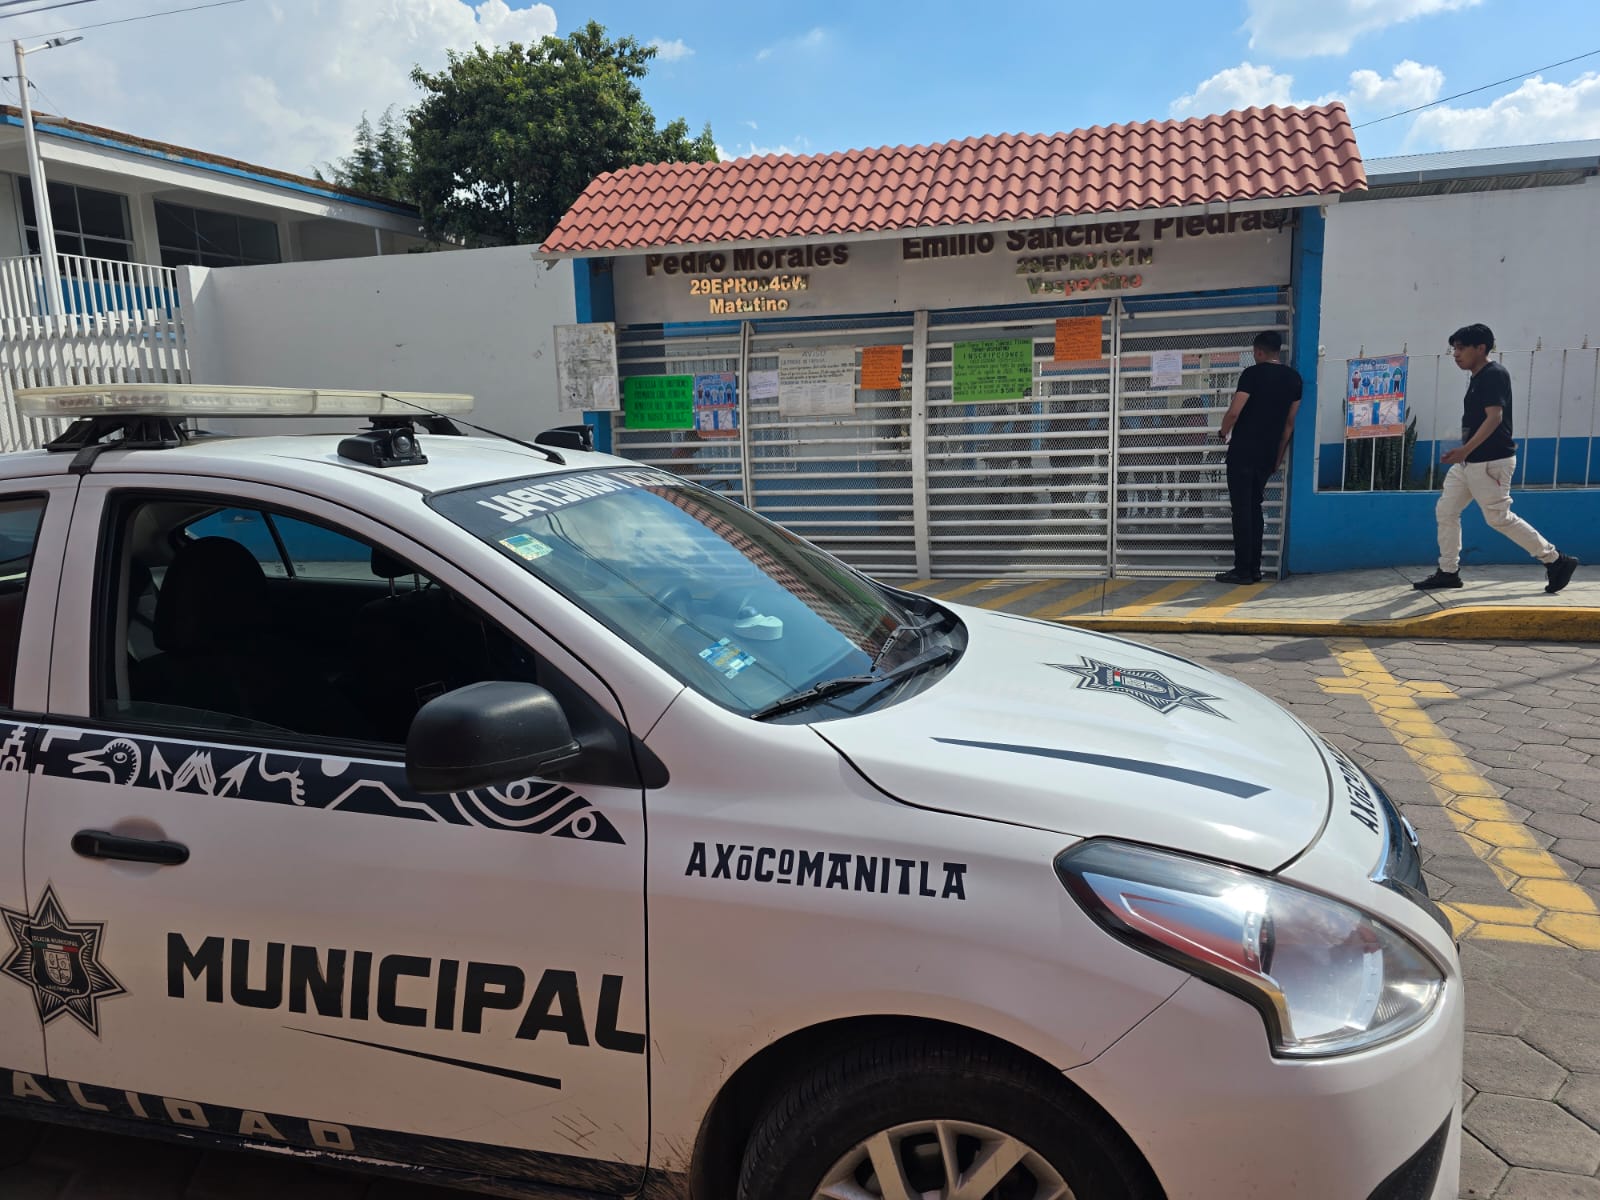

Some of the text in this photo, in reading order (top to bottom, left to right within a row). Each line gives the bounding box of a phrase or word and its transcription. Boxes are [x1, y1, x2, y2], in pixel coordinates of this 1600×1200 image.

[645, 243, 849, 277] Pedro Morales
[902, 233, 995, 260] Emilio
[1027, 272, 1143, 297] Vespertino
[709, 297, 790, 315] Matutino
[167, 932, 646, 1055] MUNICIPAL
